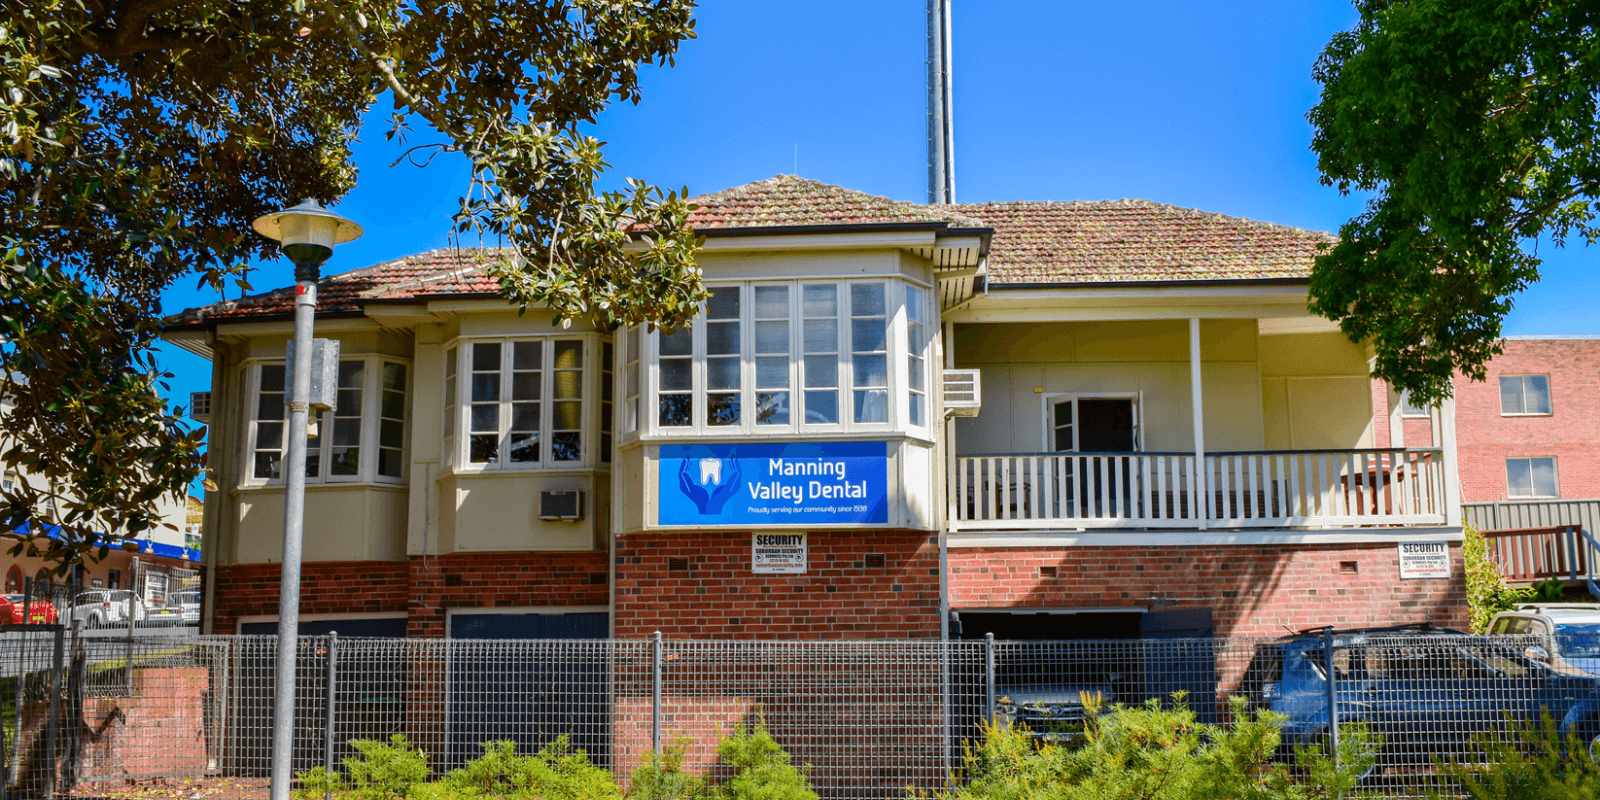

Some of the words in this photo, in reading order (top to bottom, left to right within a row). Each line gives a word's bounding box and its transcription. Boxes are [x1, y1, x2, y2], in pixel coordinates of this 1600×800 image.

[769, 458, 846, 480] Manning
[748, 481, 803, 504] Valley
[809, 480, 867, 499] Dental
[747, 506, 770, 514] Proudly
[804, 506, 837, 514] community
[756, 534, 803, 546] SECURITY
[1403, 543, 1445, 553] SECURITY
